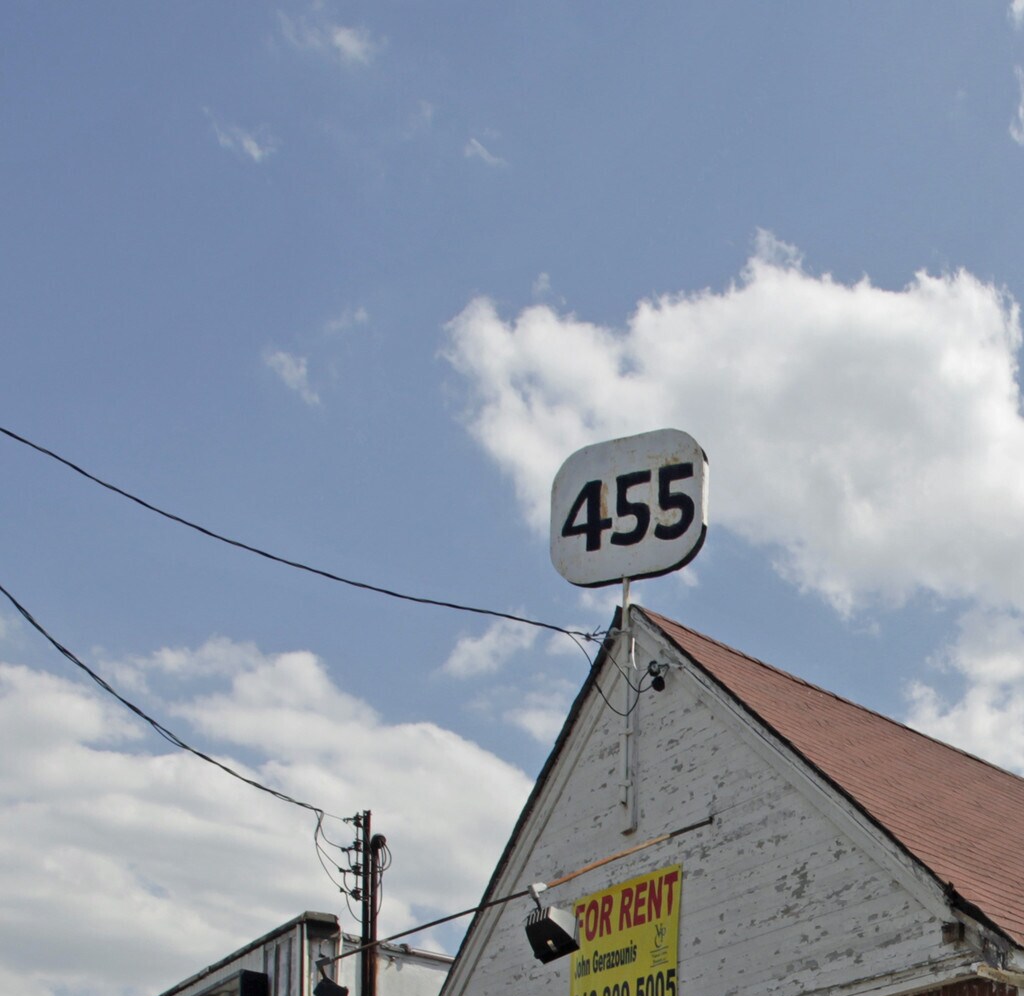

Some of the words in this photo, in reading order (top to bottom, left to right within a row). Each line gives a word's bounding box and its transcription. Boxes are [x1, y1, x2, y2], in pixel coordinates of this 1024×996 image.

[562, 463, 695, 552] 455
[576, 895, 614, 942] FOR
[619, 871, 679, 931] RENT
[593, 940, 637, 973] Gerazounis
